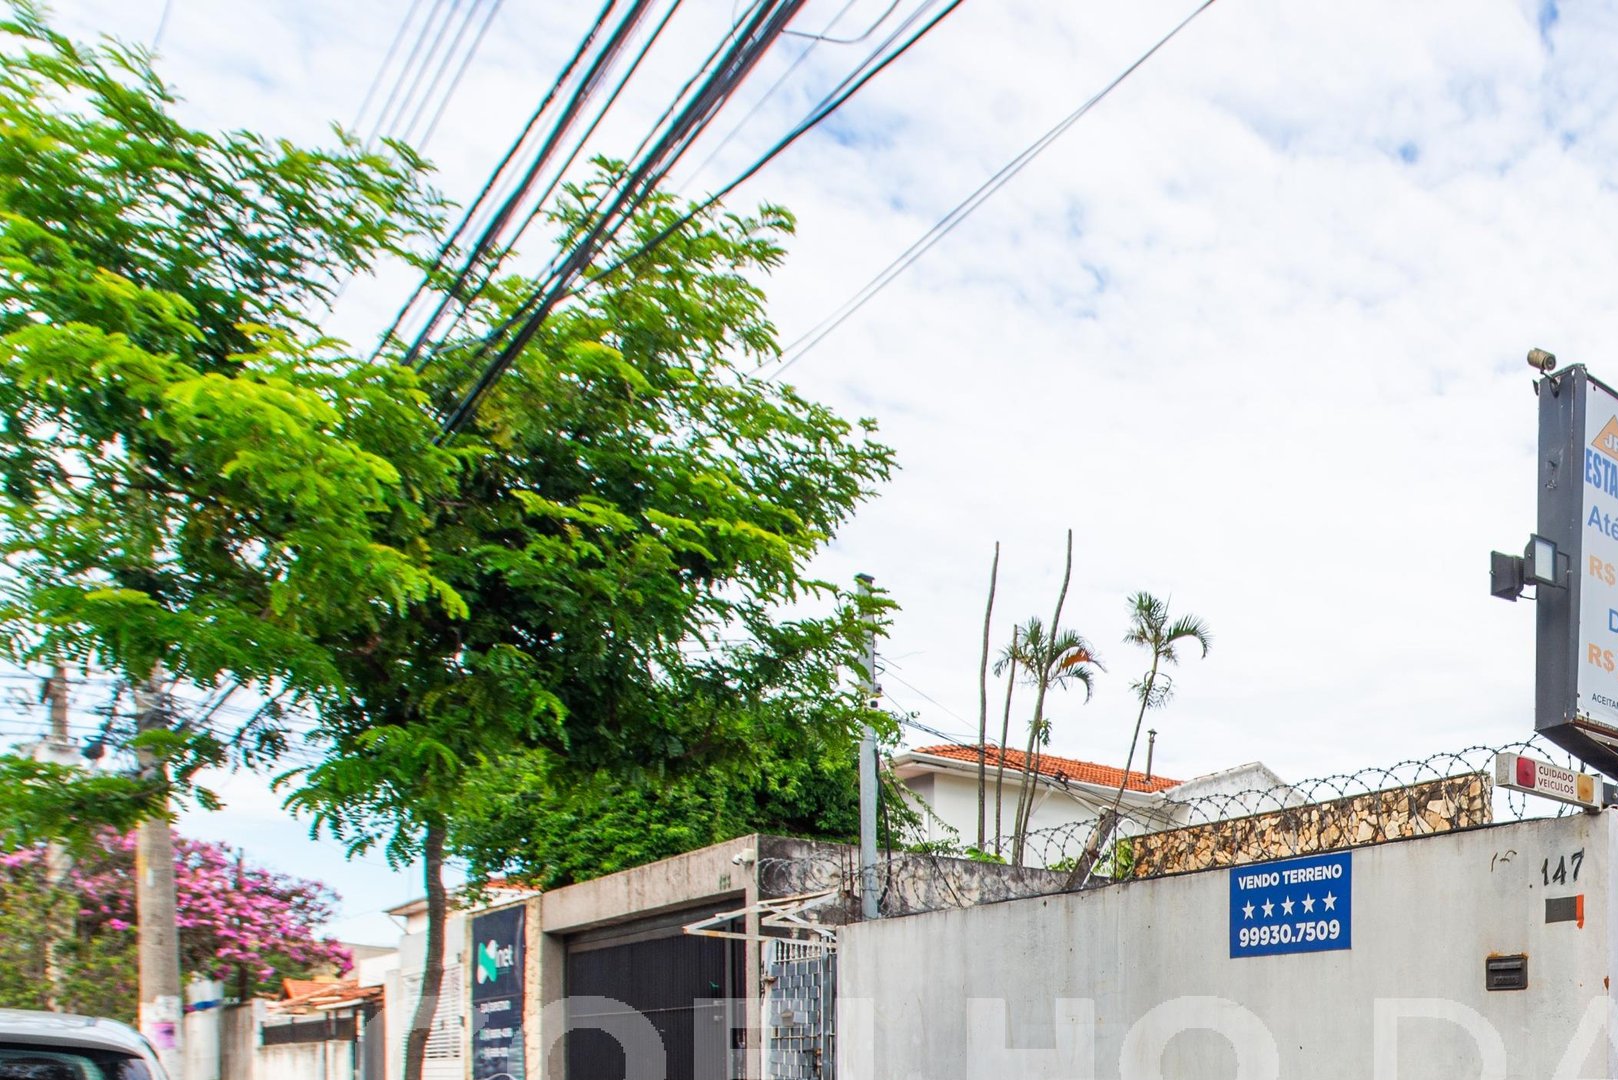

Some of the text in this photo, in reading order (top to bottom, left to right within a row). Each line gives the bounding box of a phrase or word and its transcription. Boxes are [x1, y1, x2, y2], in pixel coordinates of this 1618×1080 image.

[1539, 766, 1574, 782] CUIDADO
[1238, 864, 1342, 890] VENDO TERRENO
[1541, 847, 1585, 886] 147
[1239, 919, 1340, 947] 99930.7509
